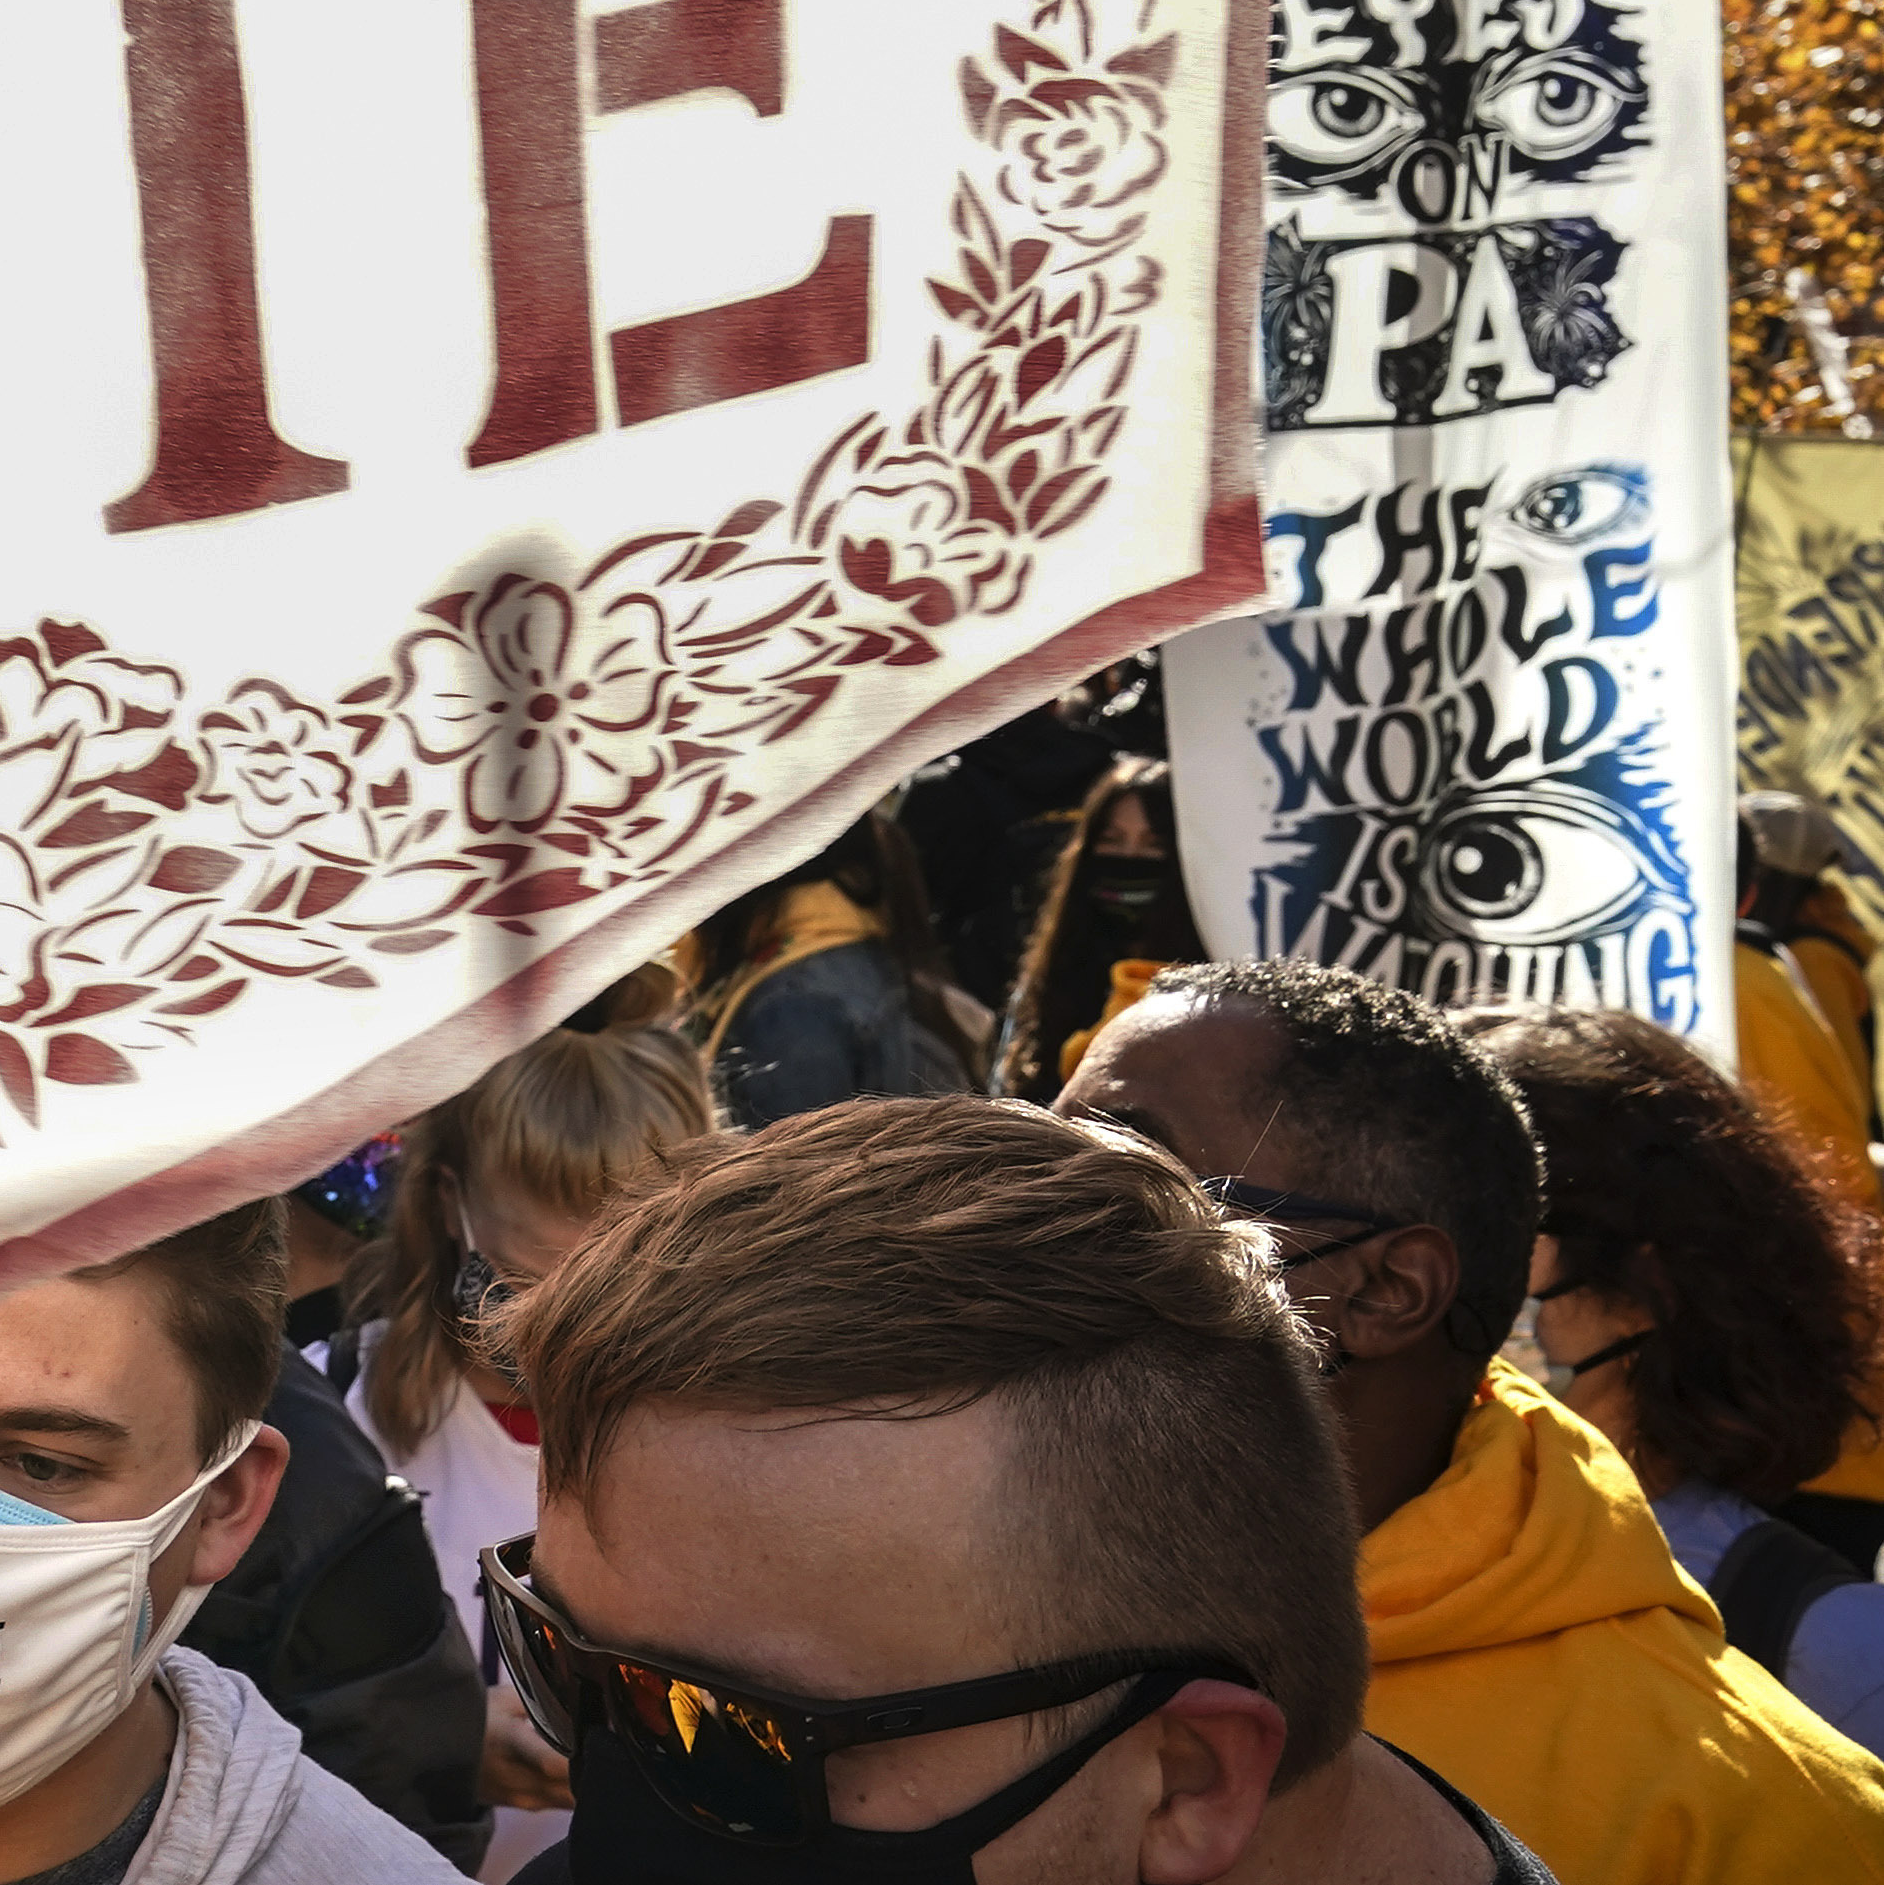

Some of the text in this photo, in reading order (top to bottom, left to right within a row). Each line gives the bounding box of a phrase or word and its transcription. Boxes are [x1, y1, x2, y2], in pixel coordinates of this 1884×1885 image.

[1397, 133, 1510, 226] ON
[1304, 234, 1557, 422] PA
[1266, 474, 1501, 608] THE
[1263, 541, 1661, 711] WHOLE
[1257, 656, 1620, 814] WORLD
[1321, 818, 1421, 920] IS
